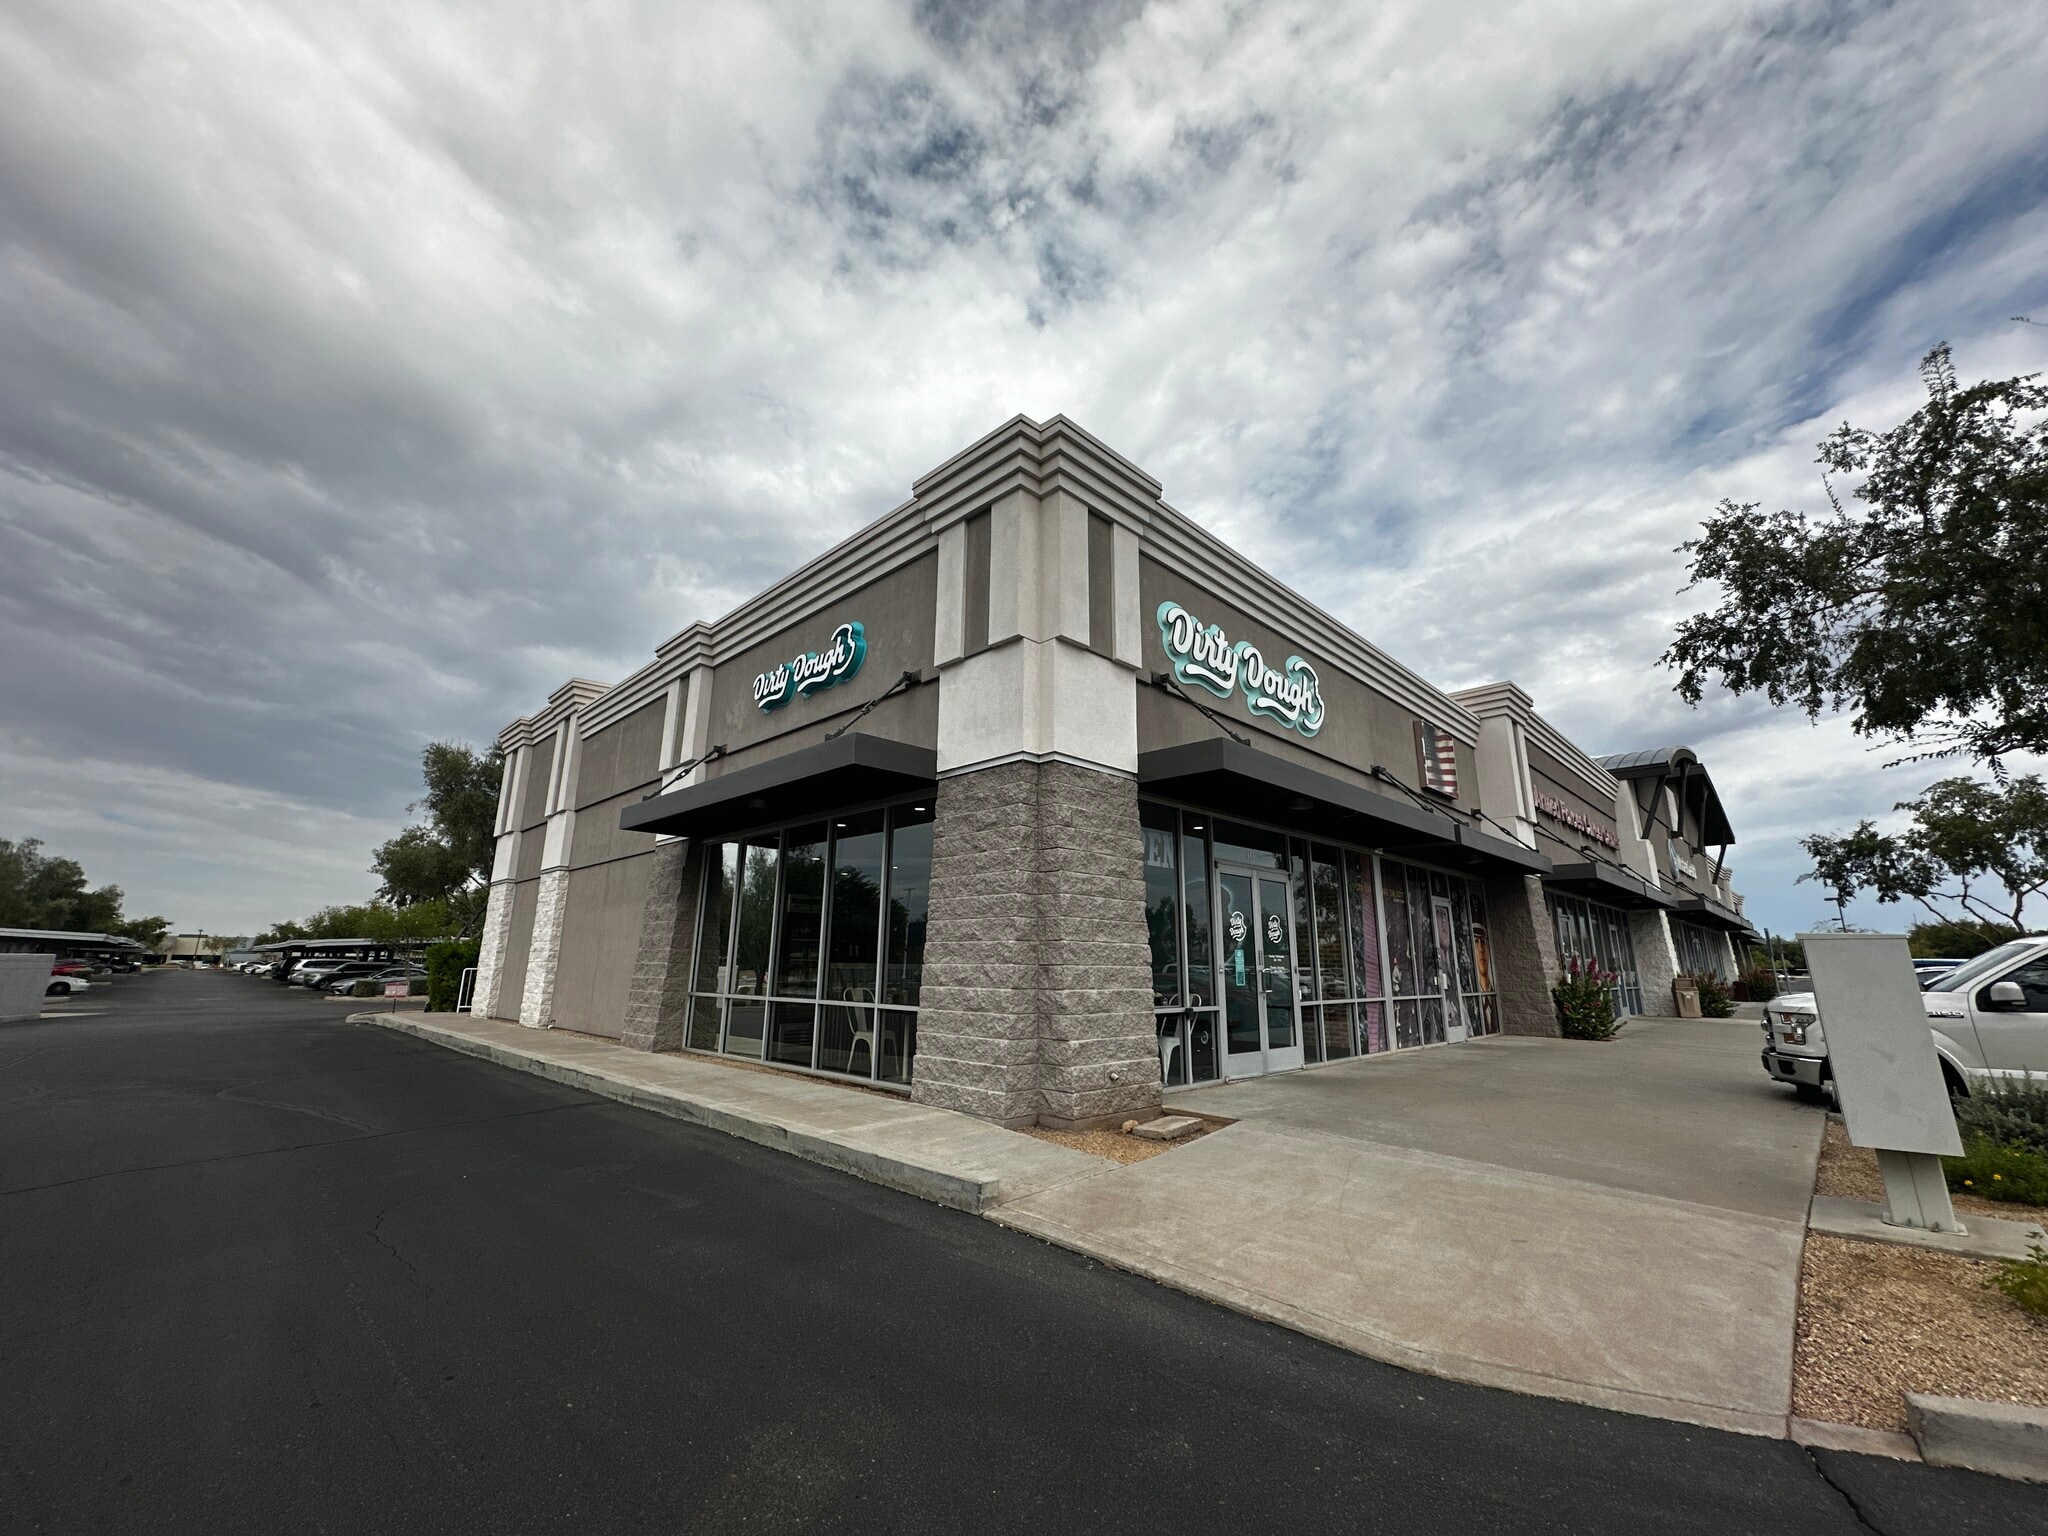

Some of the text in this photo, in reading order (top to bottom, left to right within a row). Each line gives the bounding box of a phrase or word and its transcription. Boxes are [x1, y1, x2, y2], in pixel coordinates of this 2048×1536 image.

[753, 634, 848, 708] Dirty Dough
[1167, 606, 1318, 724] Dirty Dough
